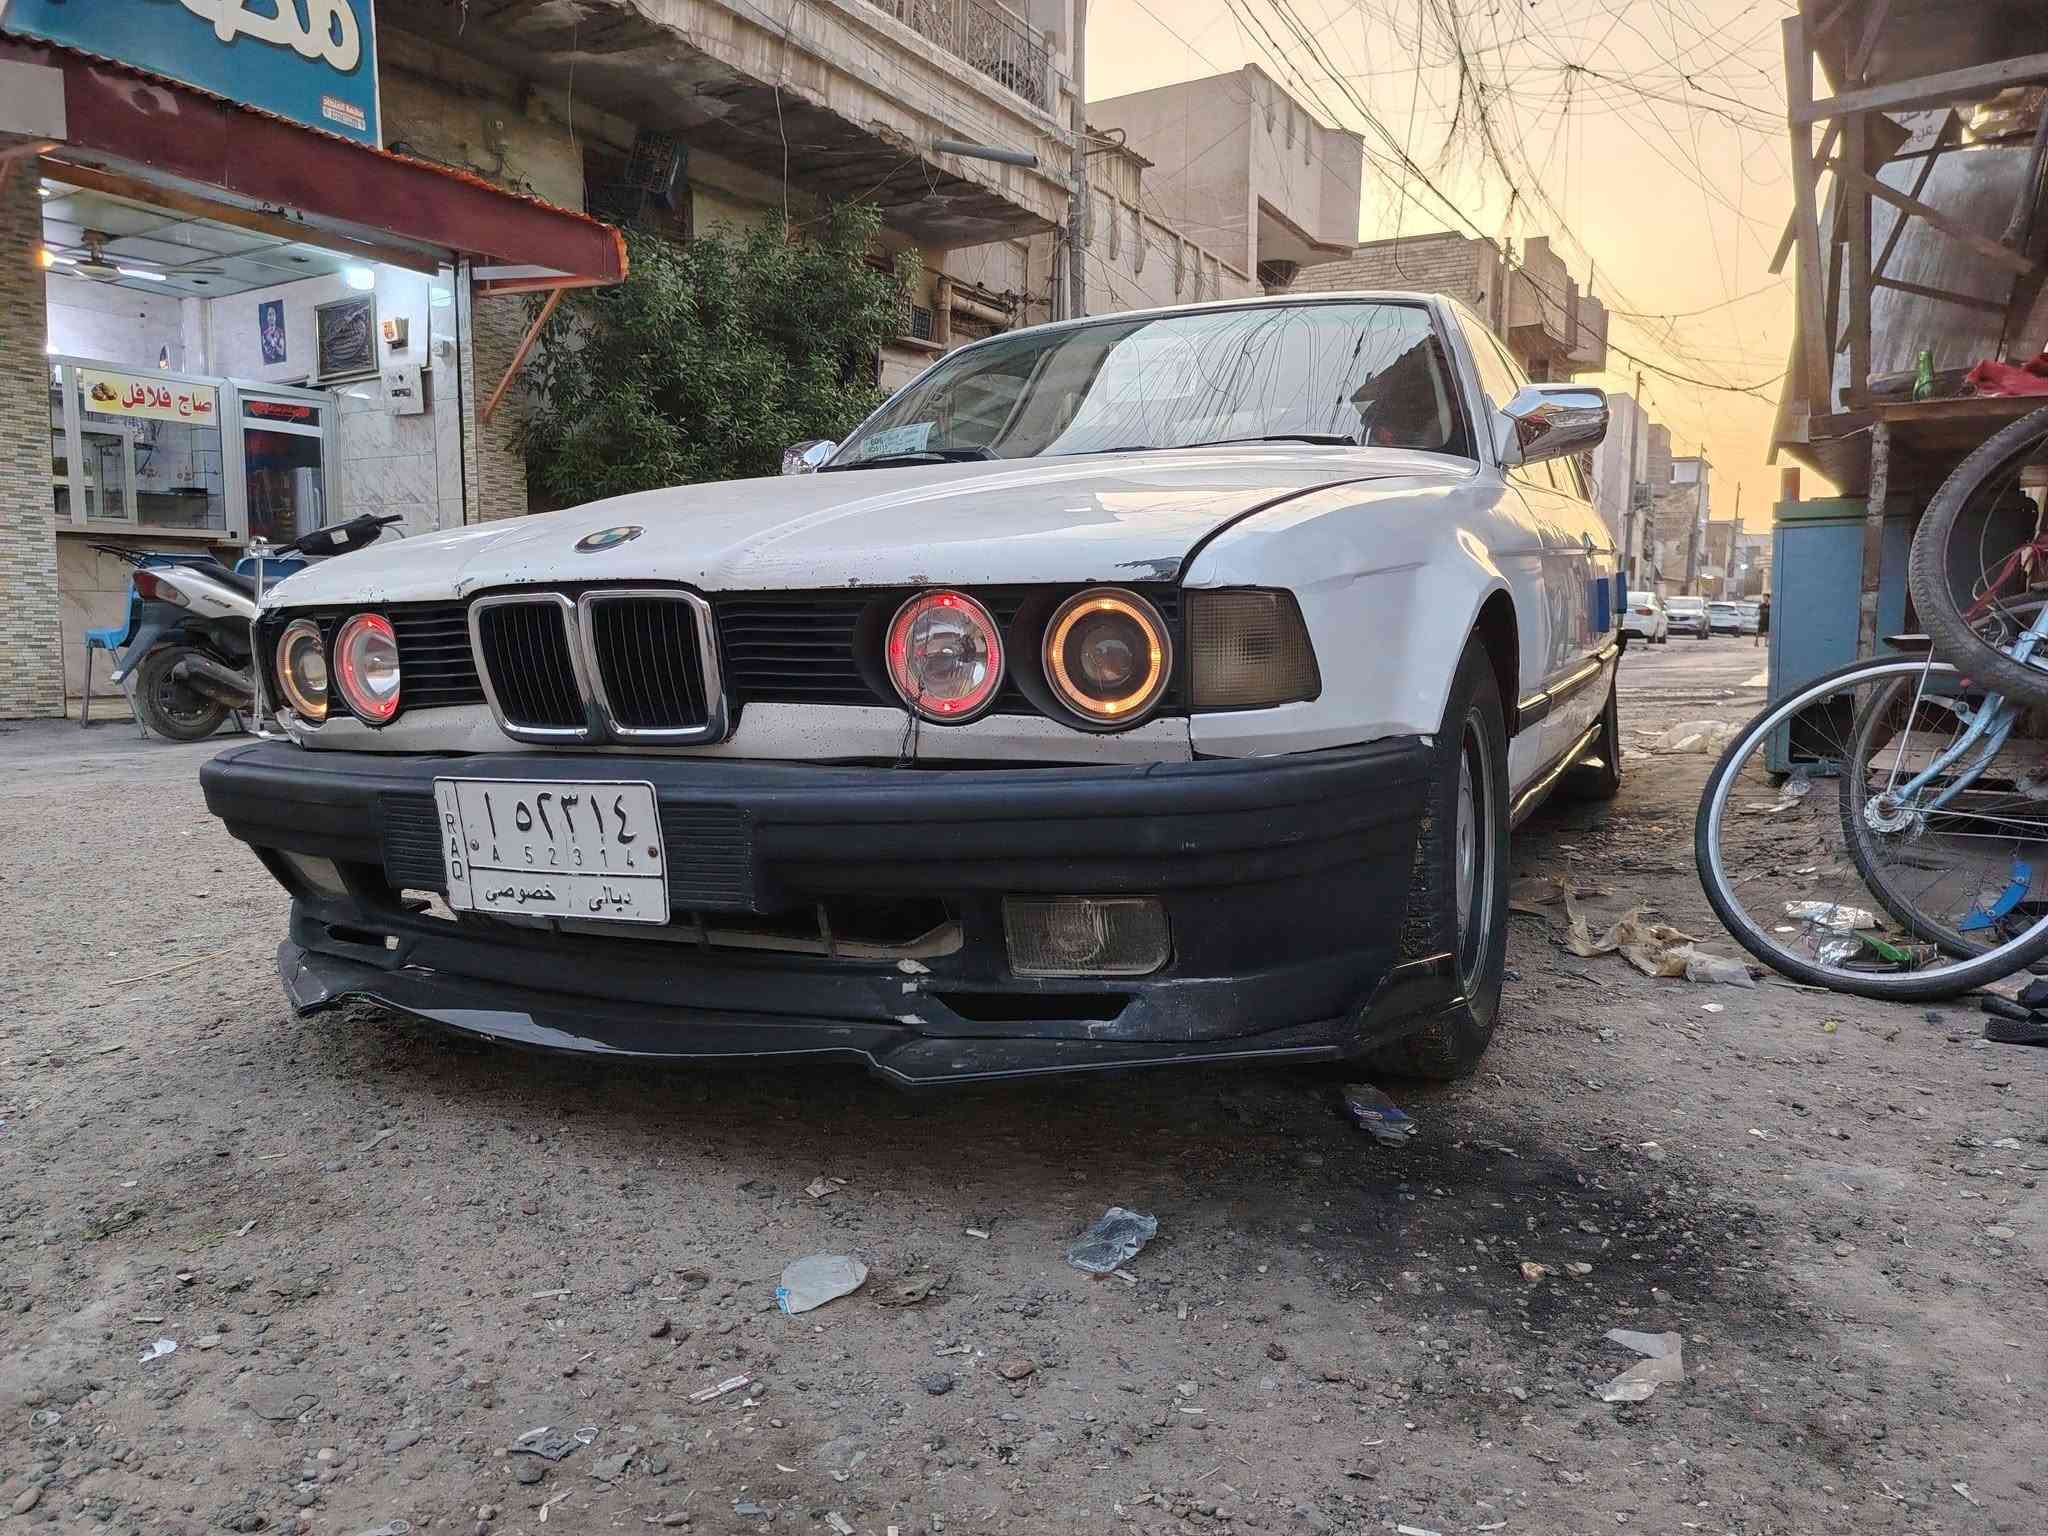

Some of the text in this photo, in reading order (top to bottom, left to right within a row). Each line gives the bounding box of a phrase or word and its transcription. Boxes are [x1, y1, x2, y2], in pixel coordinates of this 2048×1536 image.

[121, 382, 212, 416] صاج فلافل
[444, 791, 464, 880] IRAQ
[486, 883, 556, 906] خصوصي
